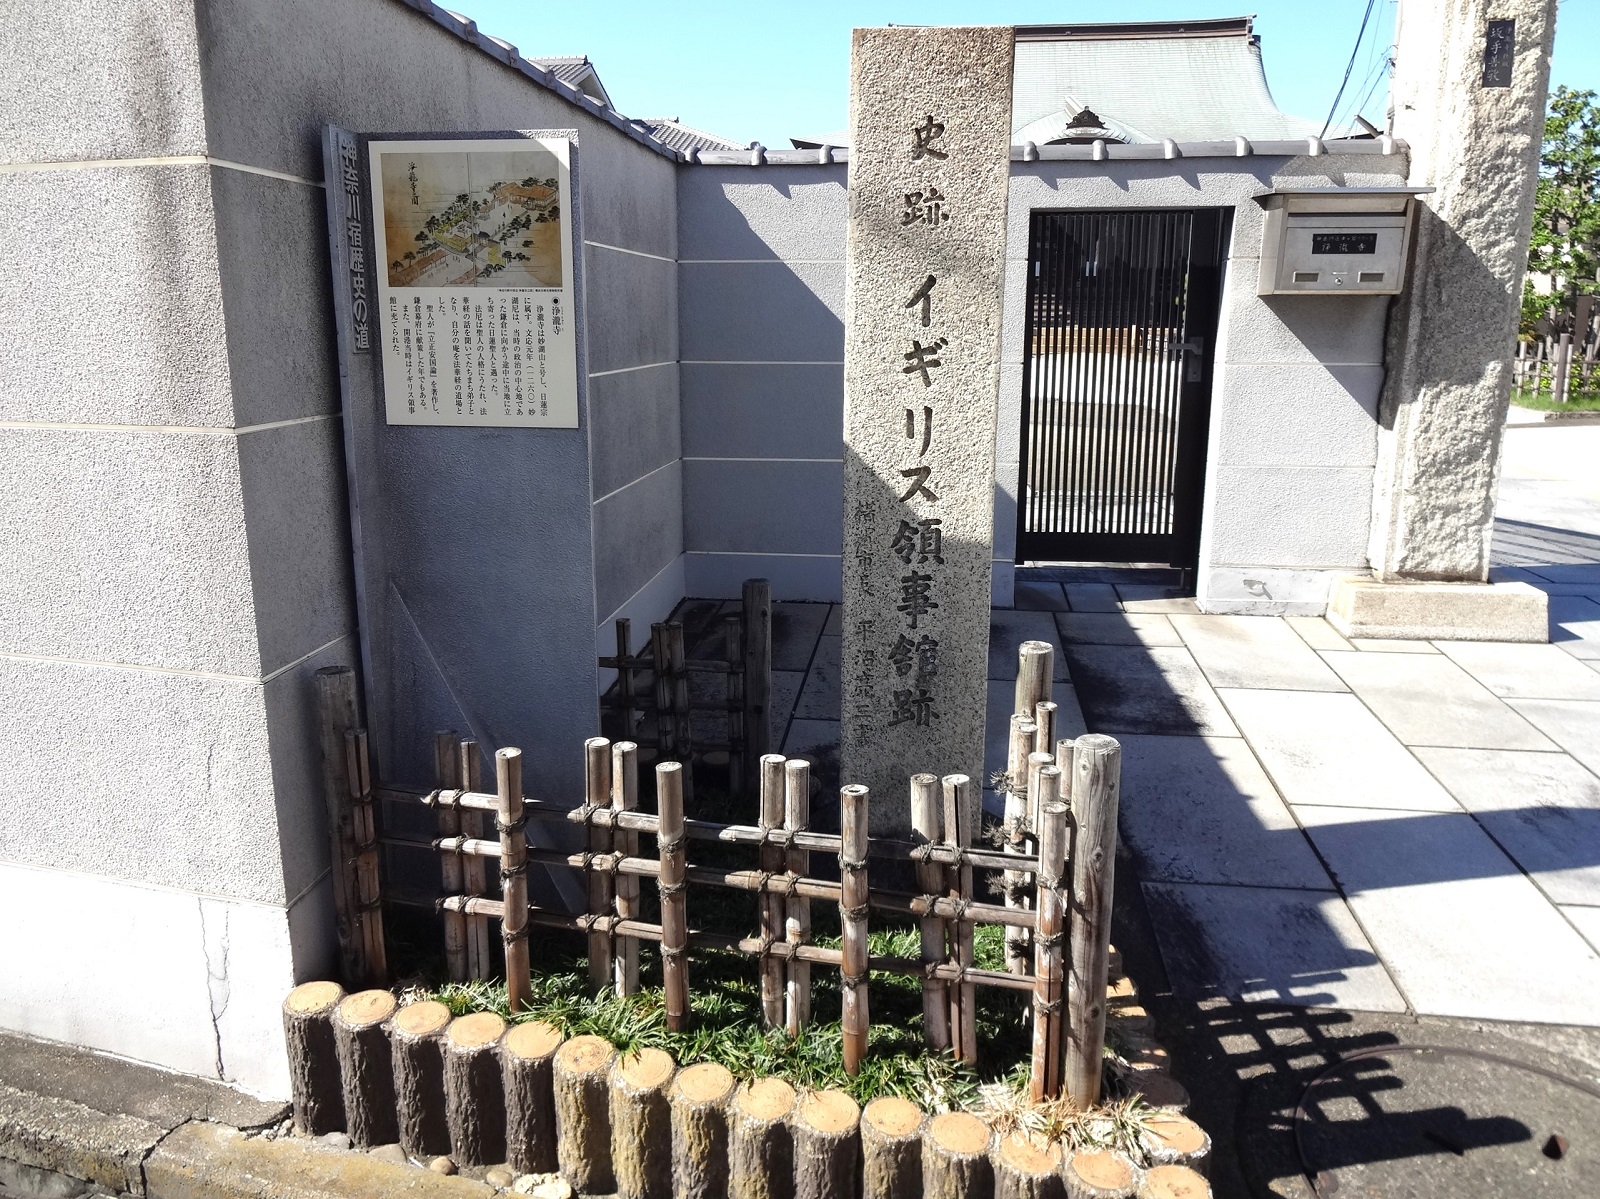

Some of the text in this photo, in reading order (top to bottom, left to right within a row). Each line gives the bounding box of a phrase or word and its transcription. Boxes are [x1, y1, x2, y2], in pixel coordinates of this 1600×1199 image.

[901, 114, 949, 227] 史跡
[341, 139, 370, 350] 神奈川宿歴史の道
[438, 296, 446, 317] した。
